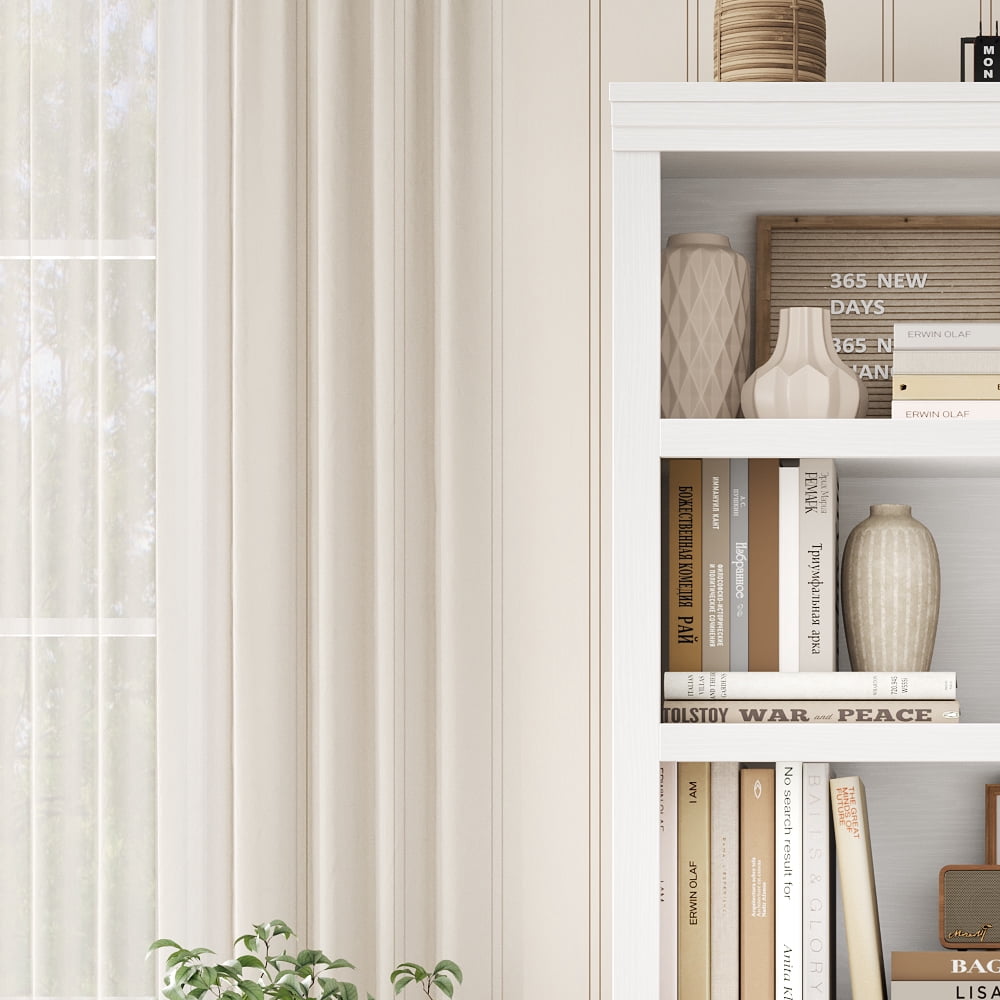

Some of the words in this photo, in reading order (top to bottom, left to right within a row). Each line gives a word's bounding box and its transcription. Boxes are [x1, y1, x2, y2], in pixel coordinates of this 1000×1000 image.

[830, 273, 867, 289] 365
[877, 273, 928, 289] NEW
[830, 299, 885, 315] DAYS
[907, 330, 942, 338] ERWIN
[944, 330, 972, 338] OLAF
[712, 476, 720, 512] ИММАНУИЛ
[804, 472, 818, 514] РЕМАРК
[678, 486, 694, 560] БОЖЕСТВЕННАЯ
[712, 513, 720, 530] КАНТ
[676, 563, 694, 608] КОМЕДИЯ
[732, 542, 747, 599] Избранное
[806, 543, 824, 625] Триумфальная
[678, 616, 698, 644] РАЙ
[807, 630, 822, 655] арка
[662, 708, 728, 724] TOLSTOY
[739, 708, 810, 722] WAR
[814, 713, 833, 721] and
[838, 708, 932, 722] PEACE
[689, 781, 698, 798] AM
[783, 766, 794, 786] No
[836, 788, 844, 826] FUTURE
[841, 787, 850, 818] MINDS
[848, 786, 857, 805] THE
[783, 789, 794, 835] search
[845, 821, 853, 833] OF
[850, 808, 861, 839] GREAT
[783, 839, 794, 876] result
[689, 860, 698, 889] OLAF
[783, 882, 794, 900] for
[689, 891, 698, 926] ERWIN
[808, 898, 823, 993] GLORY
[783, 944, 794, 982] Anita
